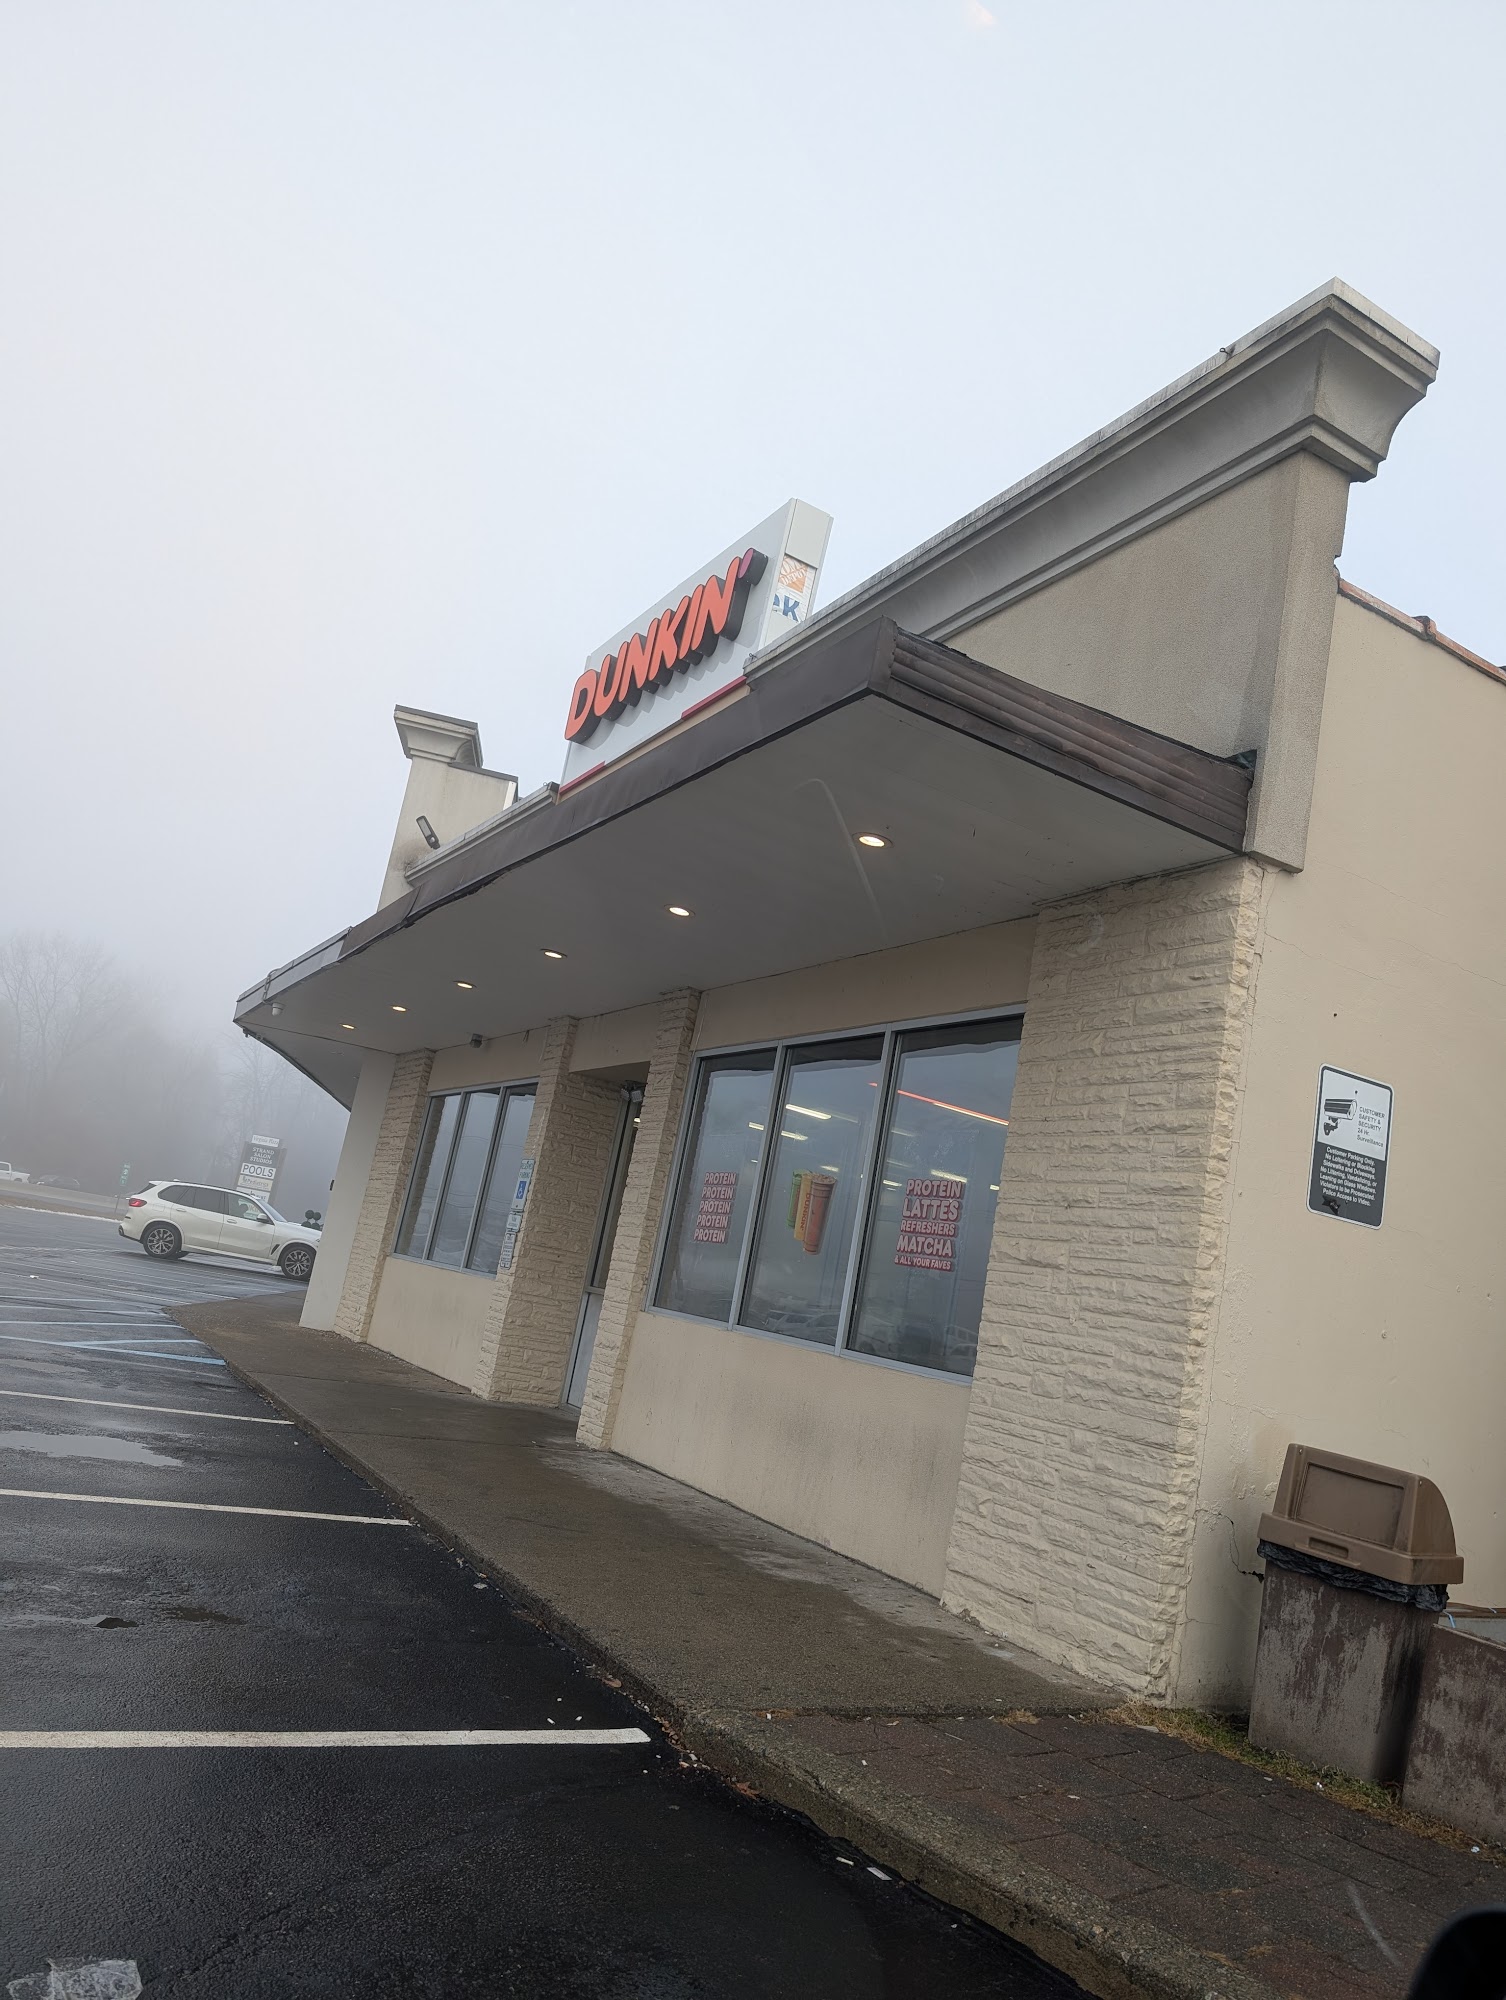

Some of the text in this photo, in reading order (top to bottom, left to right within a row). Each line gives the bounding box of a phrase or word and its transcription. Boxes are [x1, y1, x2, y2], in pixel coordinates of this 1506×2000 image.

[773, 593, 800, 622] K
[564, 547, 756, 741] DUNKIN'
[1358, 1113, 1376, 1124] SAFETY
[1360, 1106, 1385, 1118] CUSTOMER
[1358, 1120, 1381, 1131] SECURITY
[1357, 1135, 1384, 1147] Surveillance
[253, 1147, 275, 1155] STRAND
[1327, 1146, 1347, 1157] Customer
[1348, 1152, 1364, 1163] Parking
[250, 1156, 273, 1165] STUDIOS
[1323, 1159, 1344, 1171] Sidewalks
[1332, 1155, 1351, 1167] Loitering
[1356, 1162, 1376, 1174] Blocking
[242, 1164, 274, 1178] POOLS
[704, 1172, 737, 1185] PROTEIN
[1320, 1173, 1337, 1184] Leaning
[1344, 1180, 1356, 1188] Glass
[1320, 1180, 1338, 1191] Violators
[701, 1186, 734, 1199] PROTEIN
[906, 1179, 963, 1198] PROTEIN
[1323, 1188, 1336, 1197] Police
[1336, 1192, 1352, 1201] Access
[699, 1200, 731, 1214] PROTEIN
[902, 1198, 960, 1221] LATTES
[696, 1214, 729, 1228] PROTEIN
[900, 1219, 956, 1236] REFRESHERS
[693, 1228, 726, 1243] PROTEIN
[896, 1235, 953, 1257] MATCHA
[894, 1255, 951, 1270] & ALL YOUR FAVES
